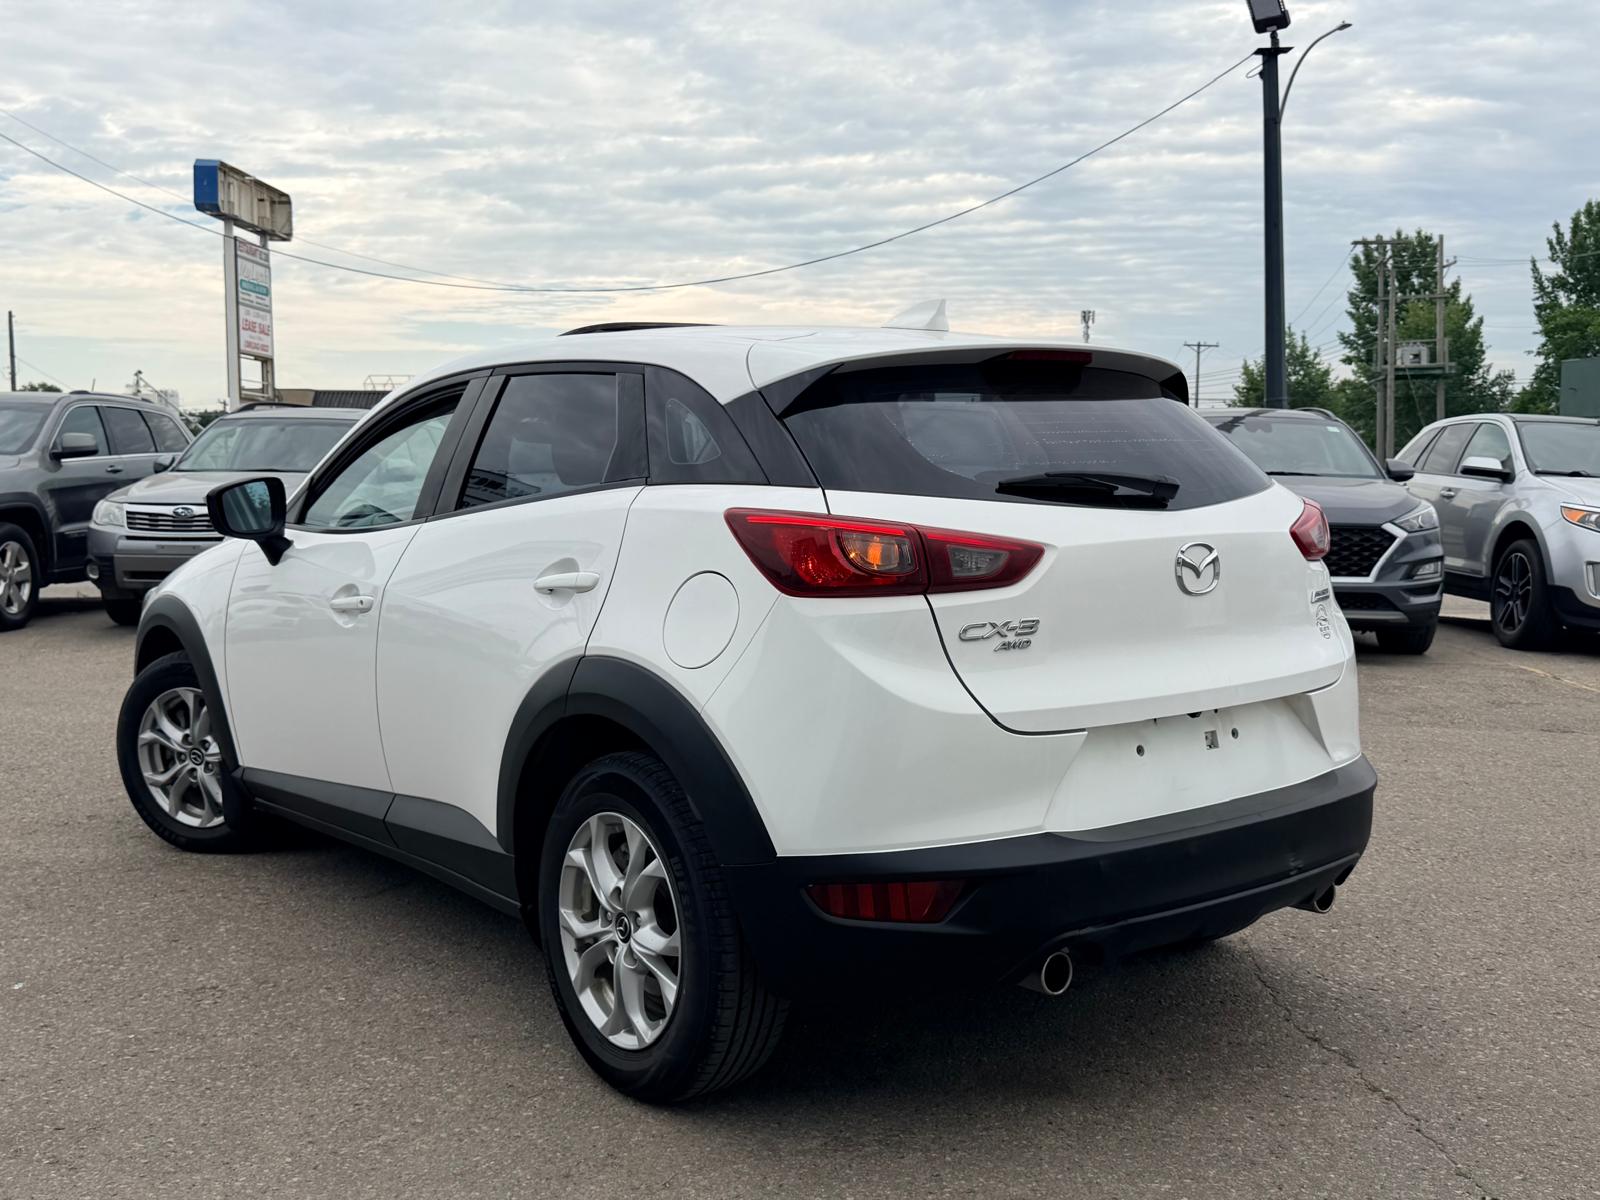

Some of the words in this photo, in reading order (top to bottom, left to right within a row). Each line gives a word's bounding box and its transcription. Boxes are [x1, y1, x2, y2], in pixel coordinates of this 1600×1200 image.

[242, 318, 257, 333] LEASE
[958, 617, 1040, 642] CX-3
[993, 638, 1032, 652] AWD
